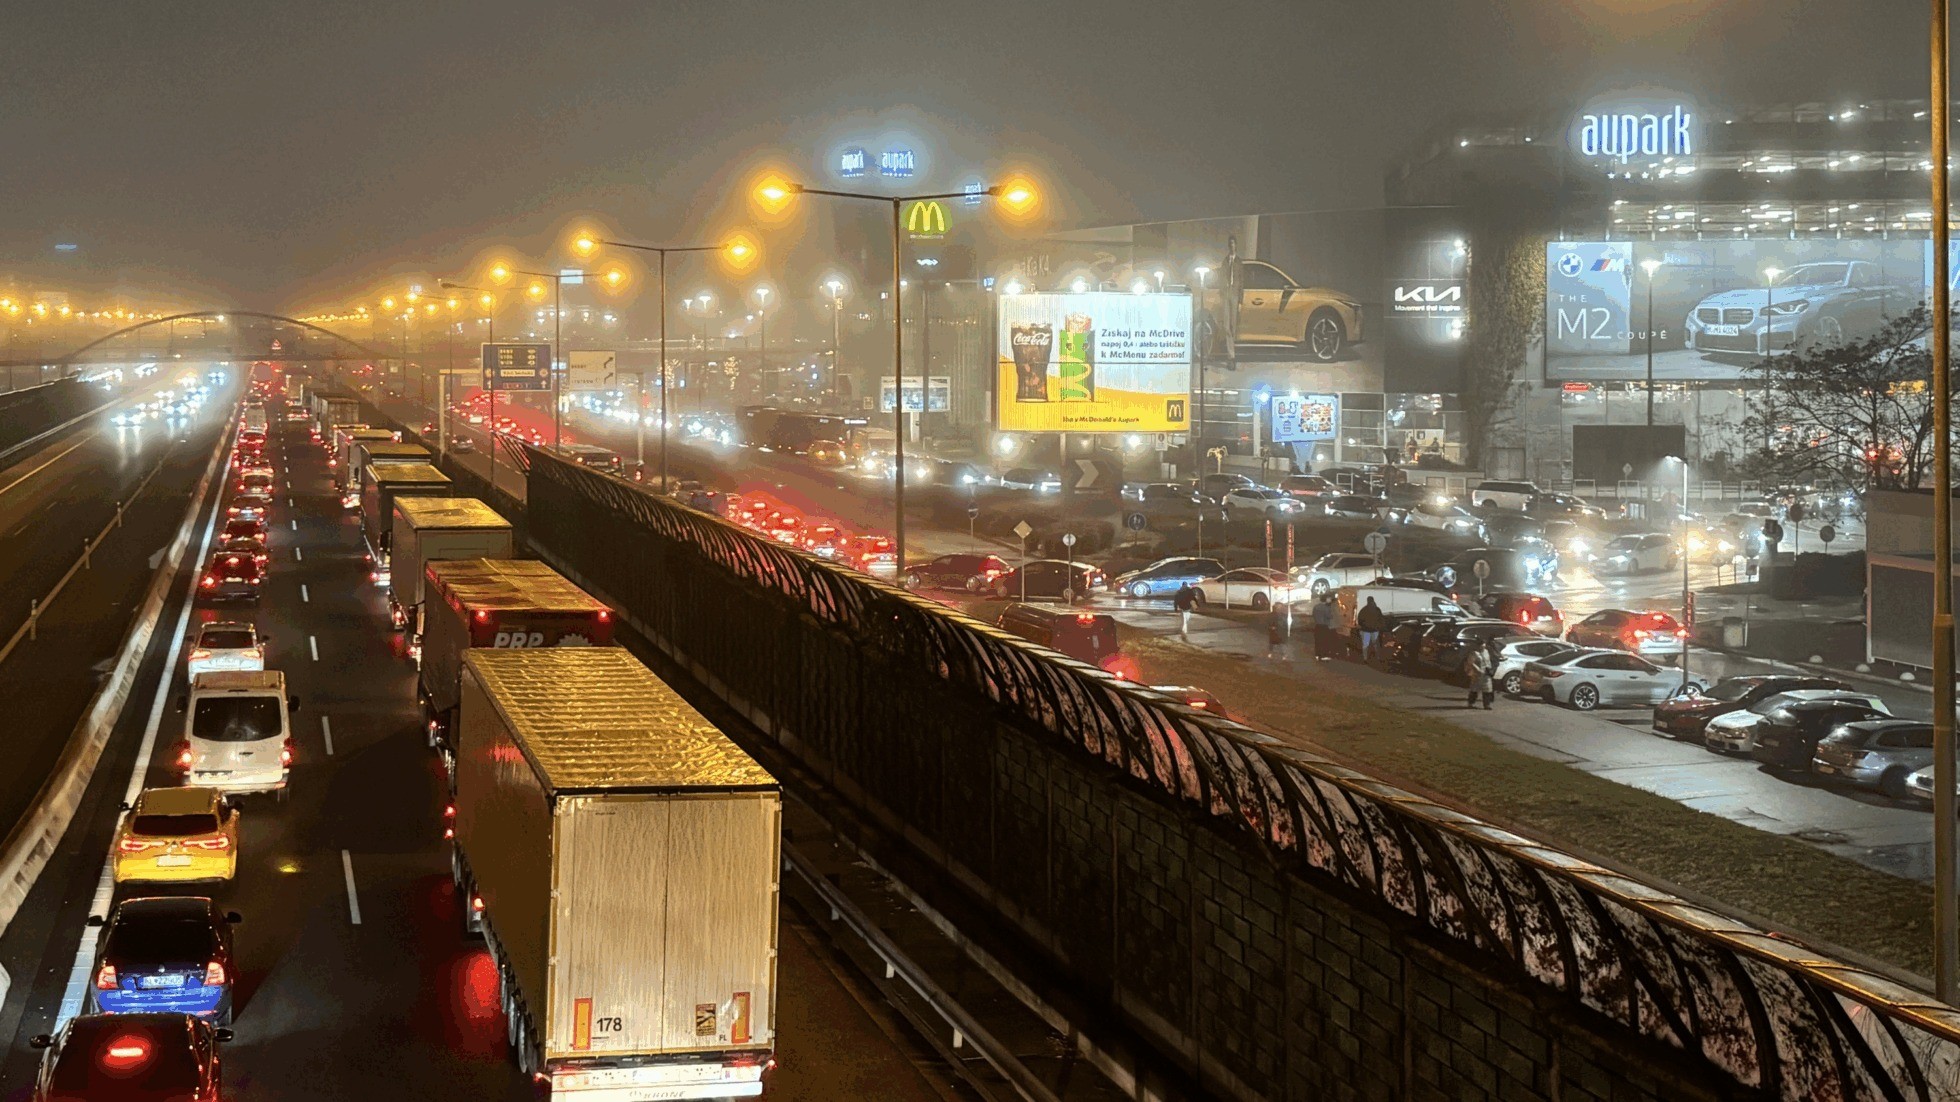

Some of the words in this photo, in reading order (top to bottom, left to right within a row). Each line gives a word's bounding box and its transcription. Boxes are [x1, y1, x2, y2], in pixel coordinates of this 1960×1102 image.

[1582, 105, 1691, 164] aupark
[882, 151, 914, 171] aupark
[1395, 286, 1461, 302] KIA
[1560, 294, 1588, 303] THE
[1558, 307, 1612, 340] M2
[1149, 329, 1185, 338] McDrive
[1101, 351, 1107, 359] k
[596, 1017, 622, 1032] 178
